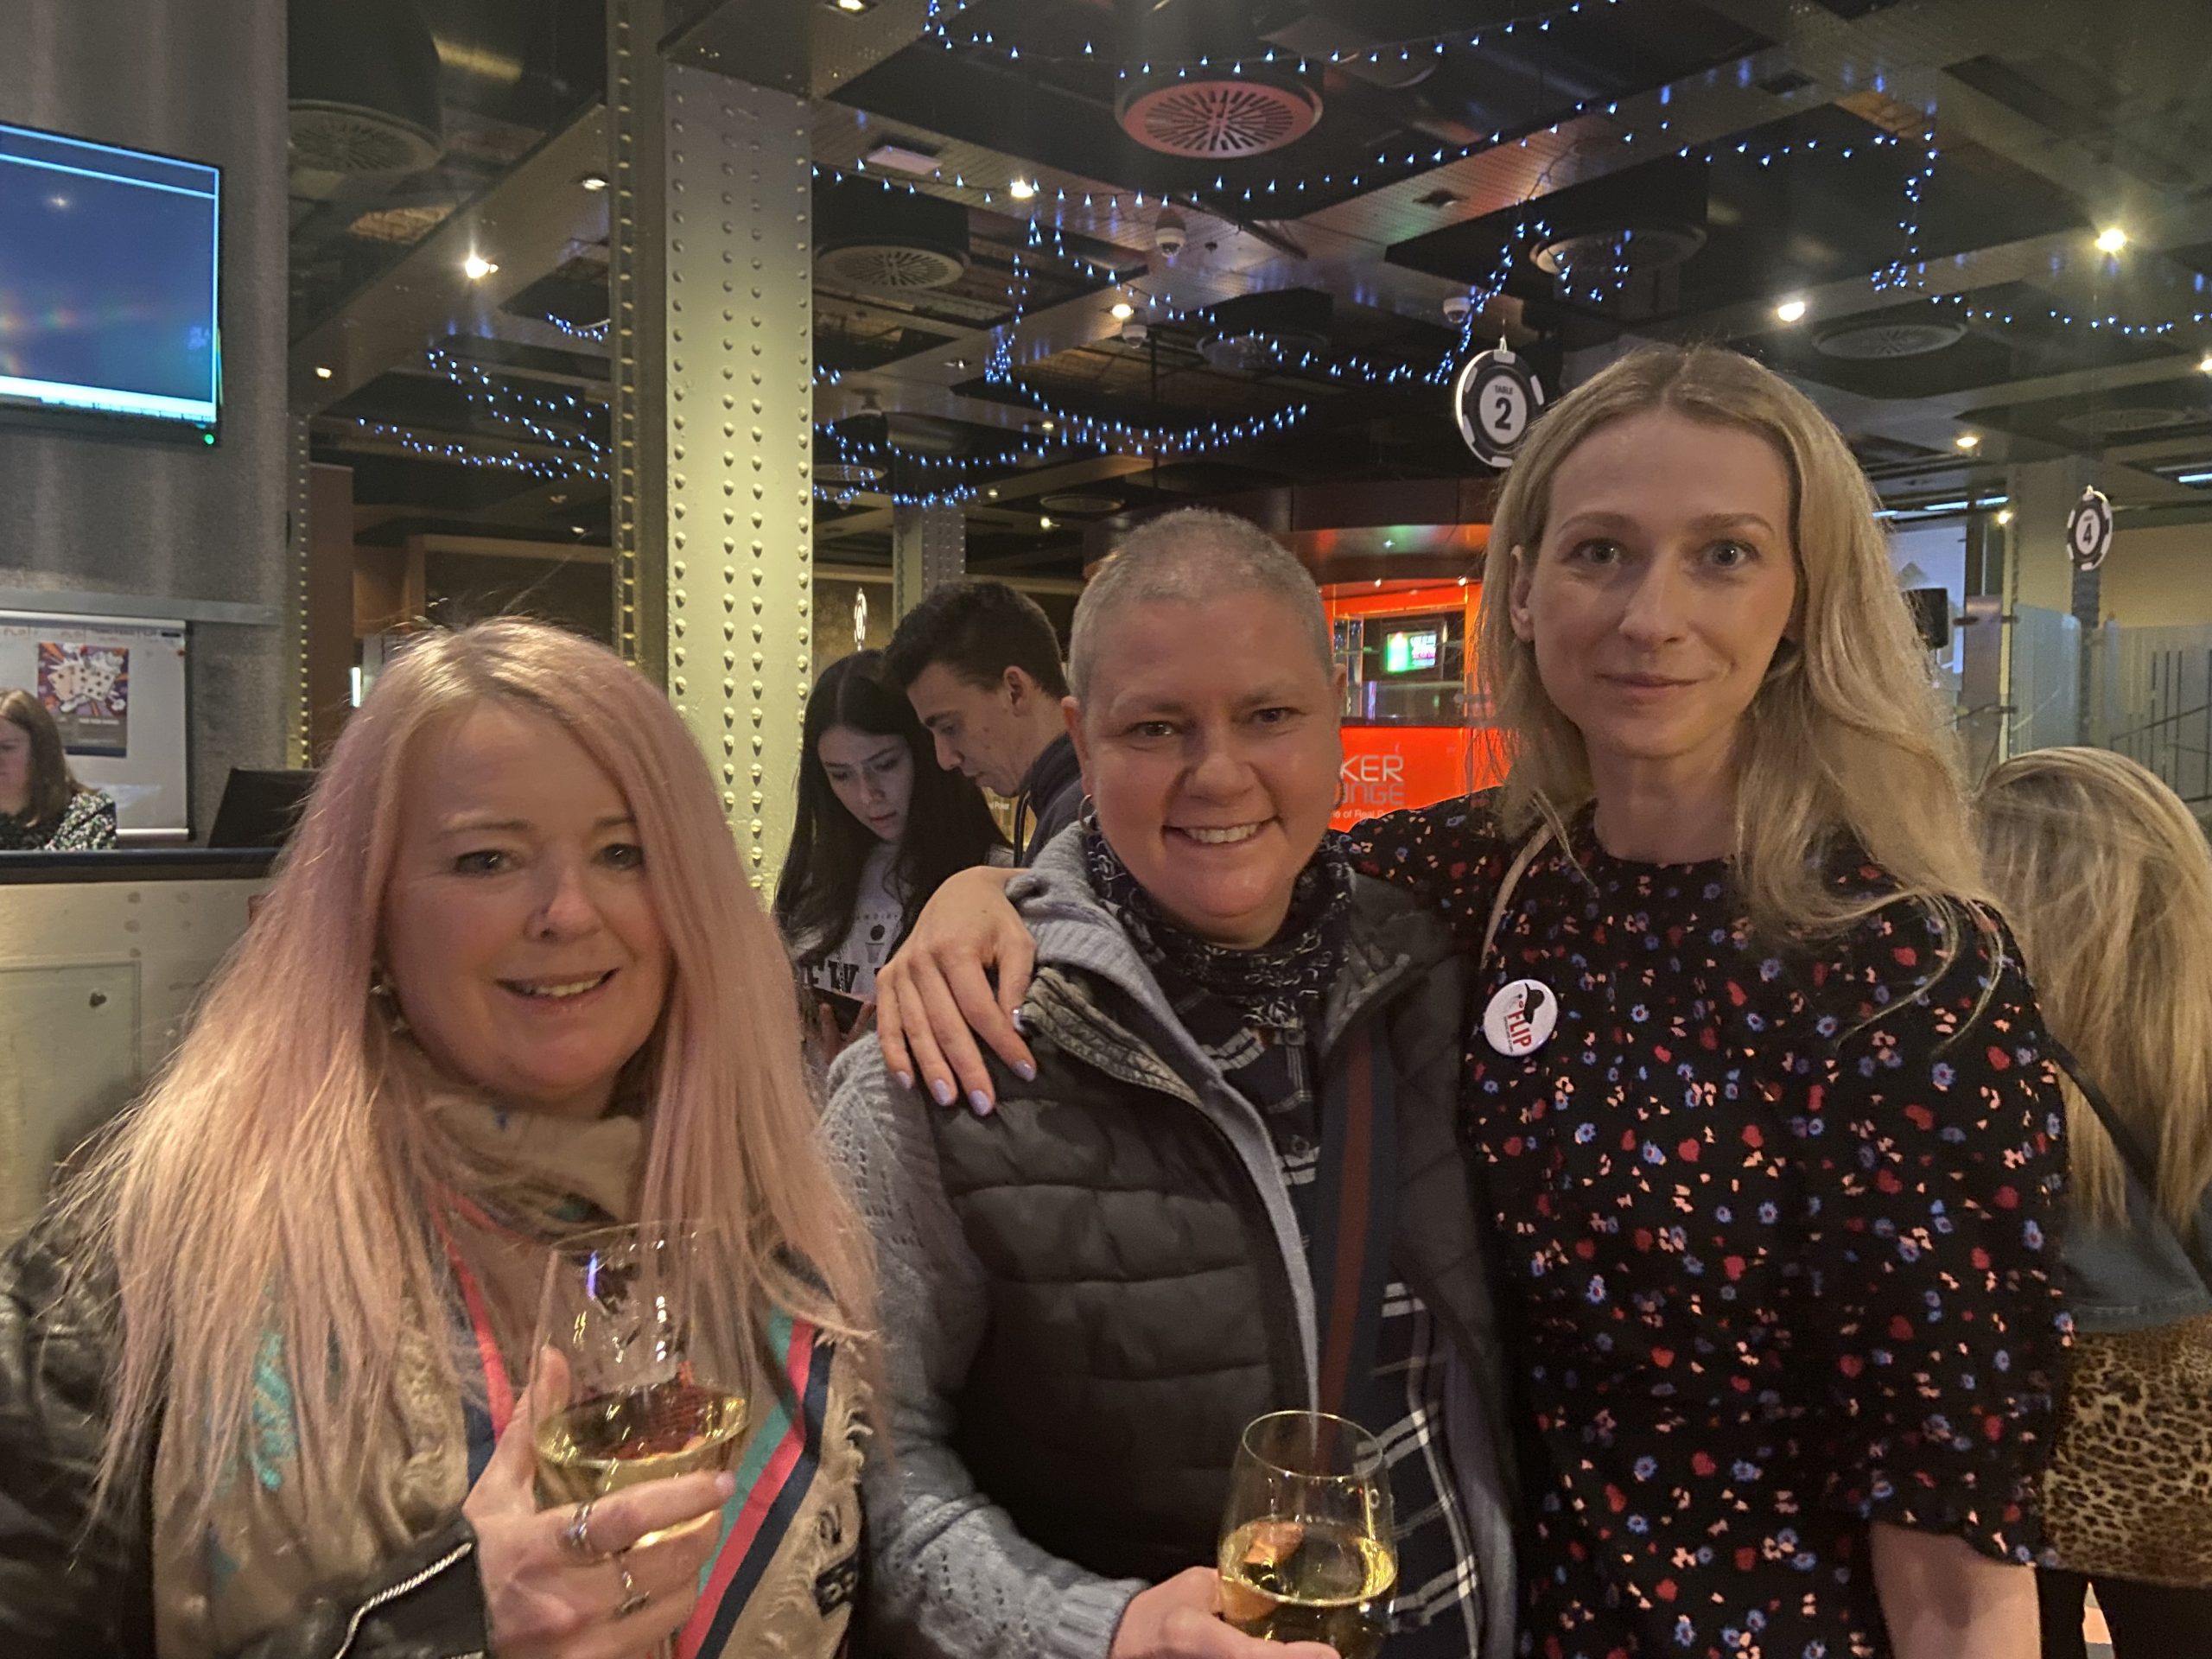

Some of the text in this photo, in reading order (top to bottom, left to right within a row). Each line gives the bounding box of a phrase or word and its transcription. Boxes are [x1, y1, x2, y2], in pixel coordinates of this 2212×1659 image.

[1494, 385, 1513, 395] TABLE
[1494, 397, 1512, 430] 2
[2082, 523, 2093, 545] 4
[1340, 754, 1404, 782] KER
[1343, 782, 1405, 805] NGE
[1507, 1009, 1532, 1047] FLIP
